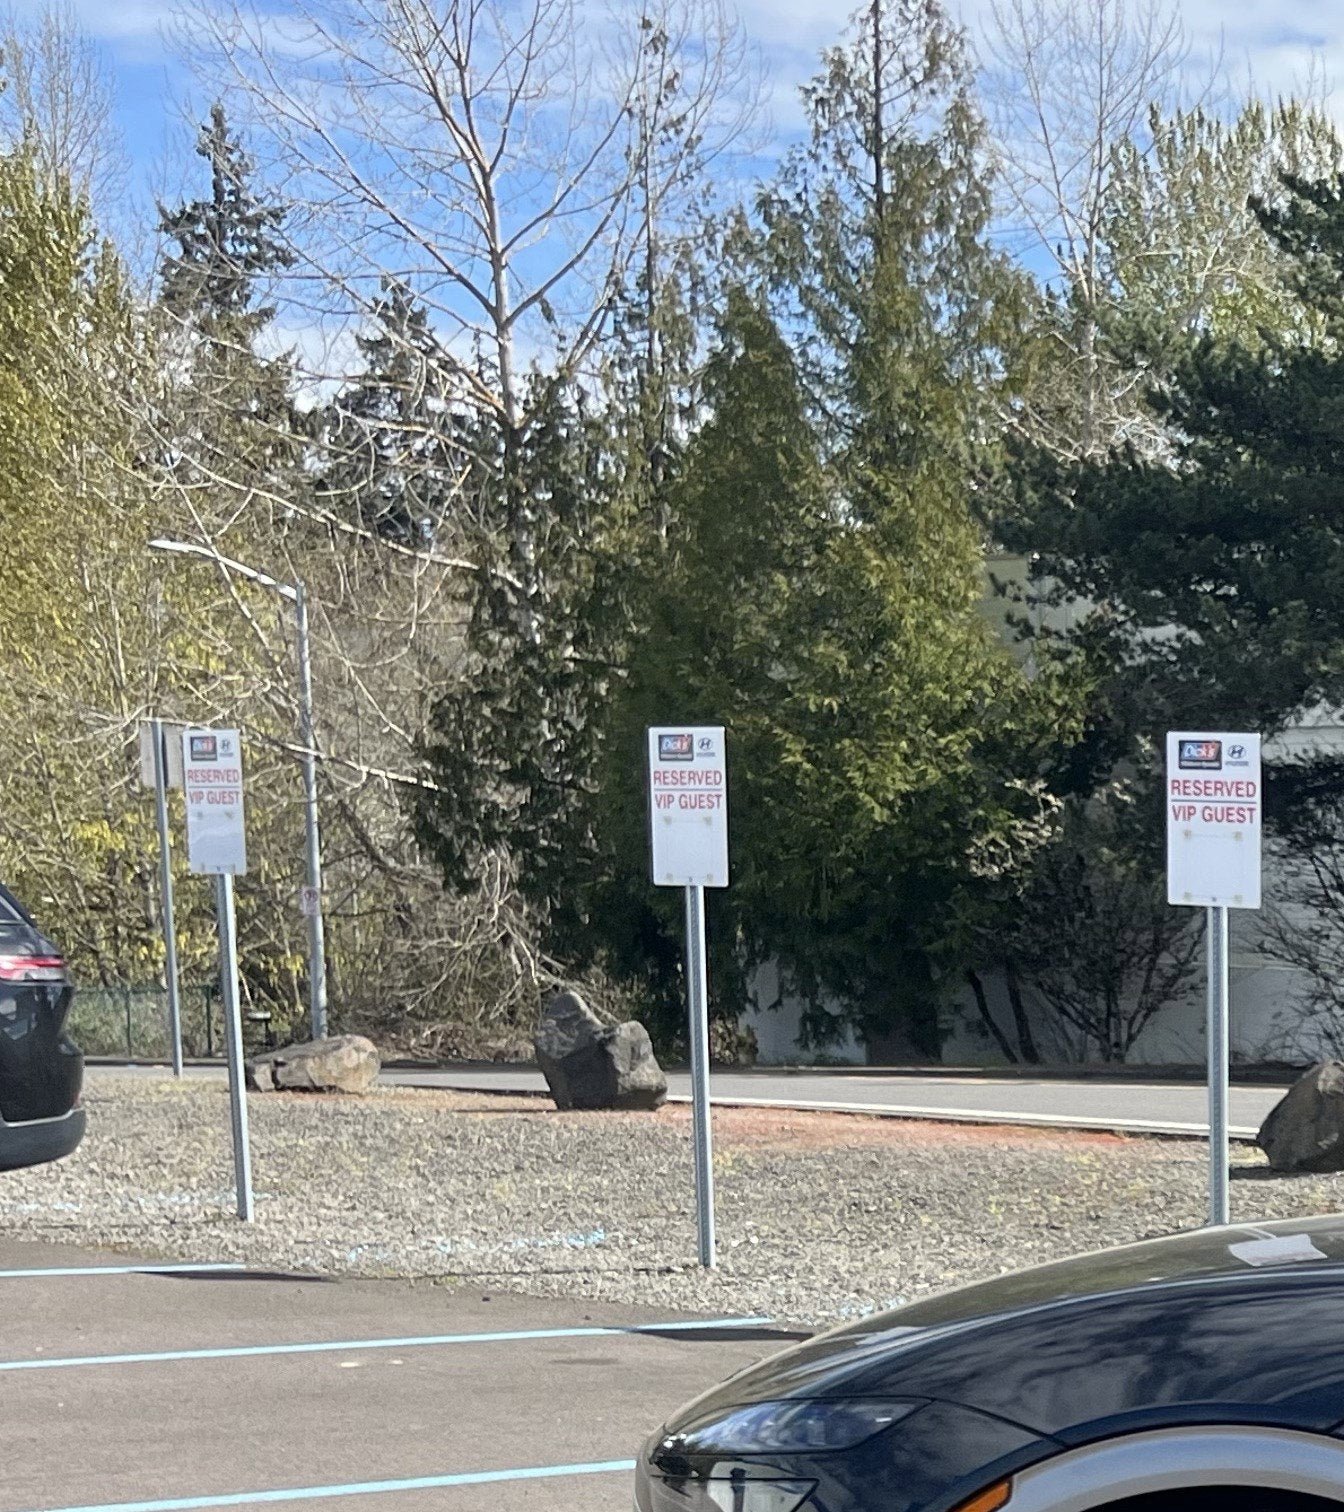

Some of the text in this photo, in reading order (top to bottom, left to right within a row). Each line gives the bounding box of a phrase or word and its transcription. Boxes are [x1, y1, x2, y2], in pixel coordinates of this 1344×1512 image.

[188, 769, 240, 783] RESERVED
[653, 770, 722, 785] RESERVED
[1171, 779, 1256, 798] RESERVED
[189, 791, 240, 804] VIP GUEST
[654, 794, 722, 809] VIP GUEST
[1172, 805, 1256, 824] VIP GUEST
